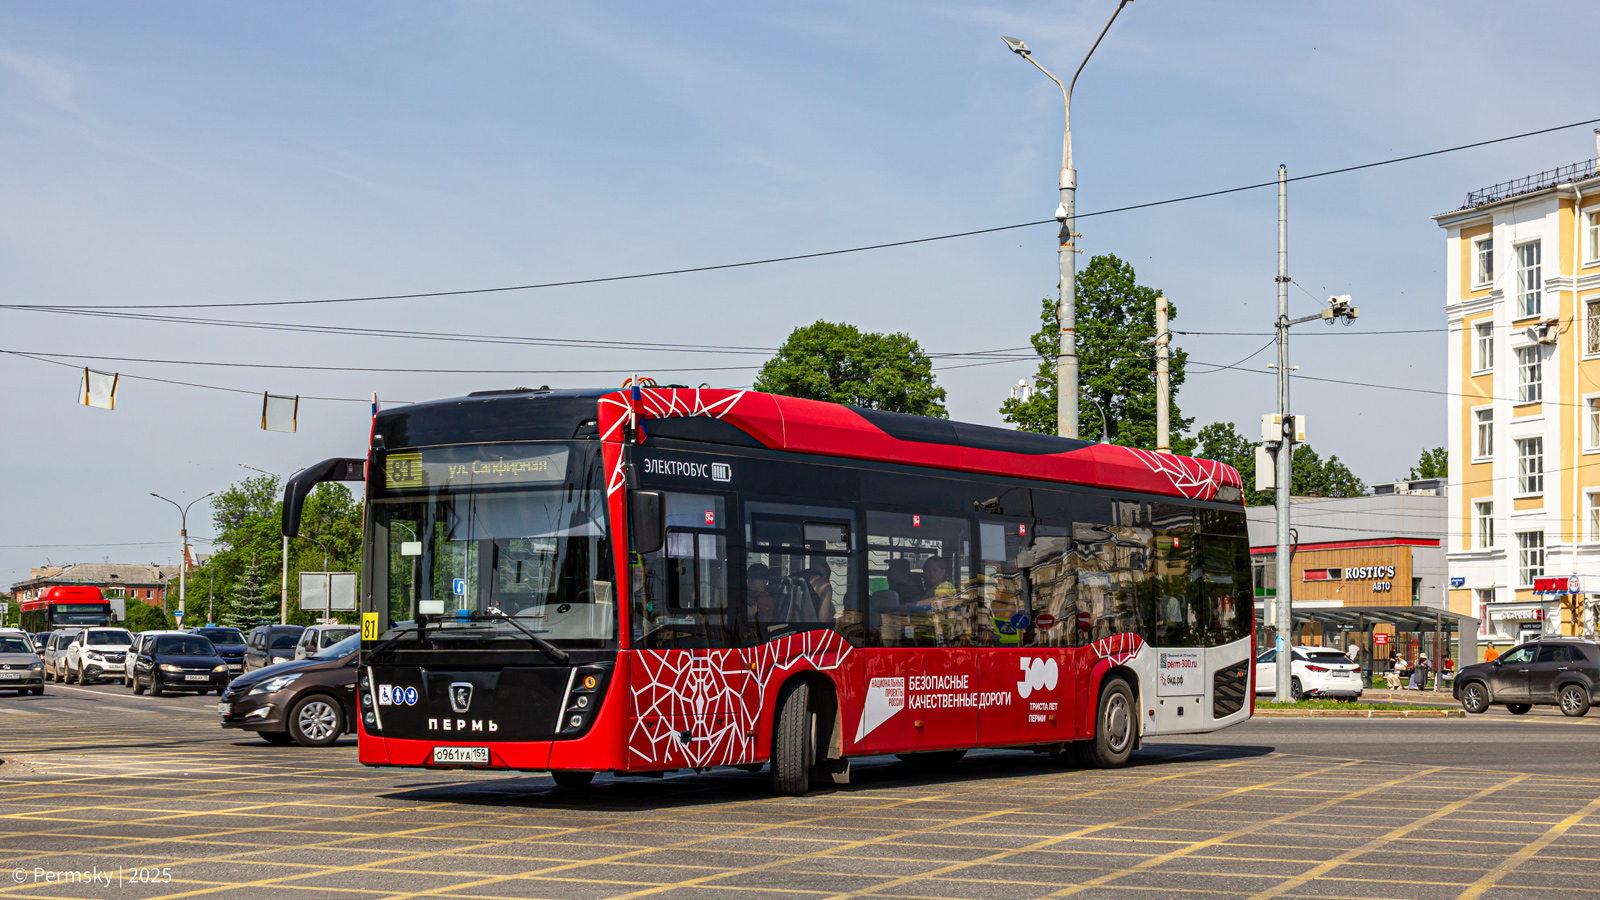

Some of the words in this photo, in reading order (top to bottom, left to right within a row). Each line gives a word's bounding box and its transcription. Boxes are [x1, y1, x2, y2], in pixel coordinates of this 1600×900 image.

[391, 459, 415, 482] 81
[449, 464, 468, 479] ул.
[472, 456, 548, 476] Сапфирная
[644, 458, 709, 478] ЭЛЕКТРОБУС
[1345, 565, 1395, 580] ROSTIC'S
[1372, 581, 1391, 592] АВТО
[364, 619, 376, 639] 81
[1167, 659, 1197, 670] perm-300.ru
[909, 675, 969, 690] БЕЗОПАСНЫЕ
[909, 693, 978, 709] КАЧЕСТВЕННЫЕ
[979, 692, 1012, 709] ДОРОГИ
[1029, 702, 1048, 711] ТРИСТА
[428, 718, 498, 732] ПЕРМЬ
[1028, 714, 1046, 722] ПЕРМИ
